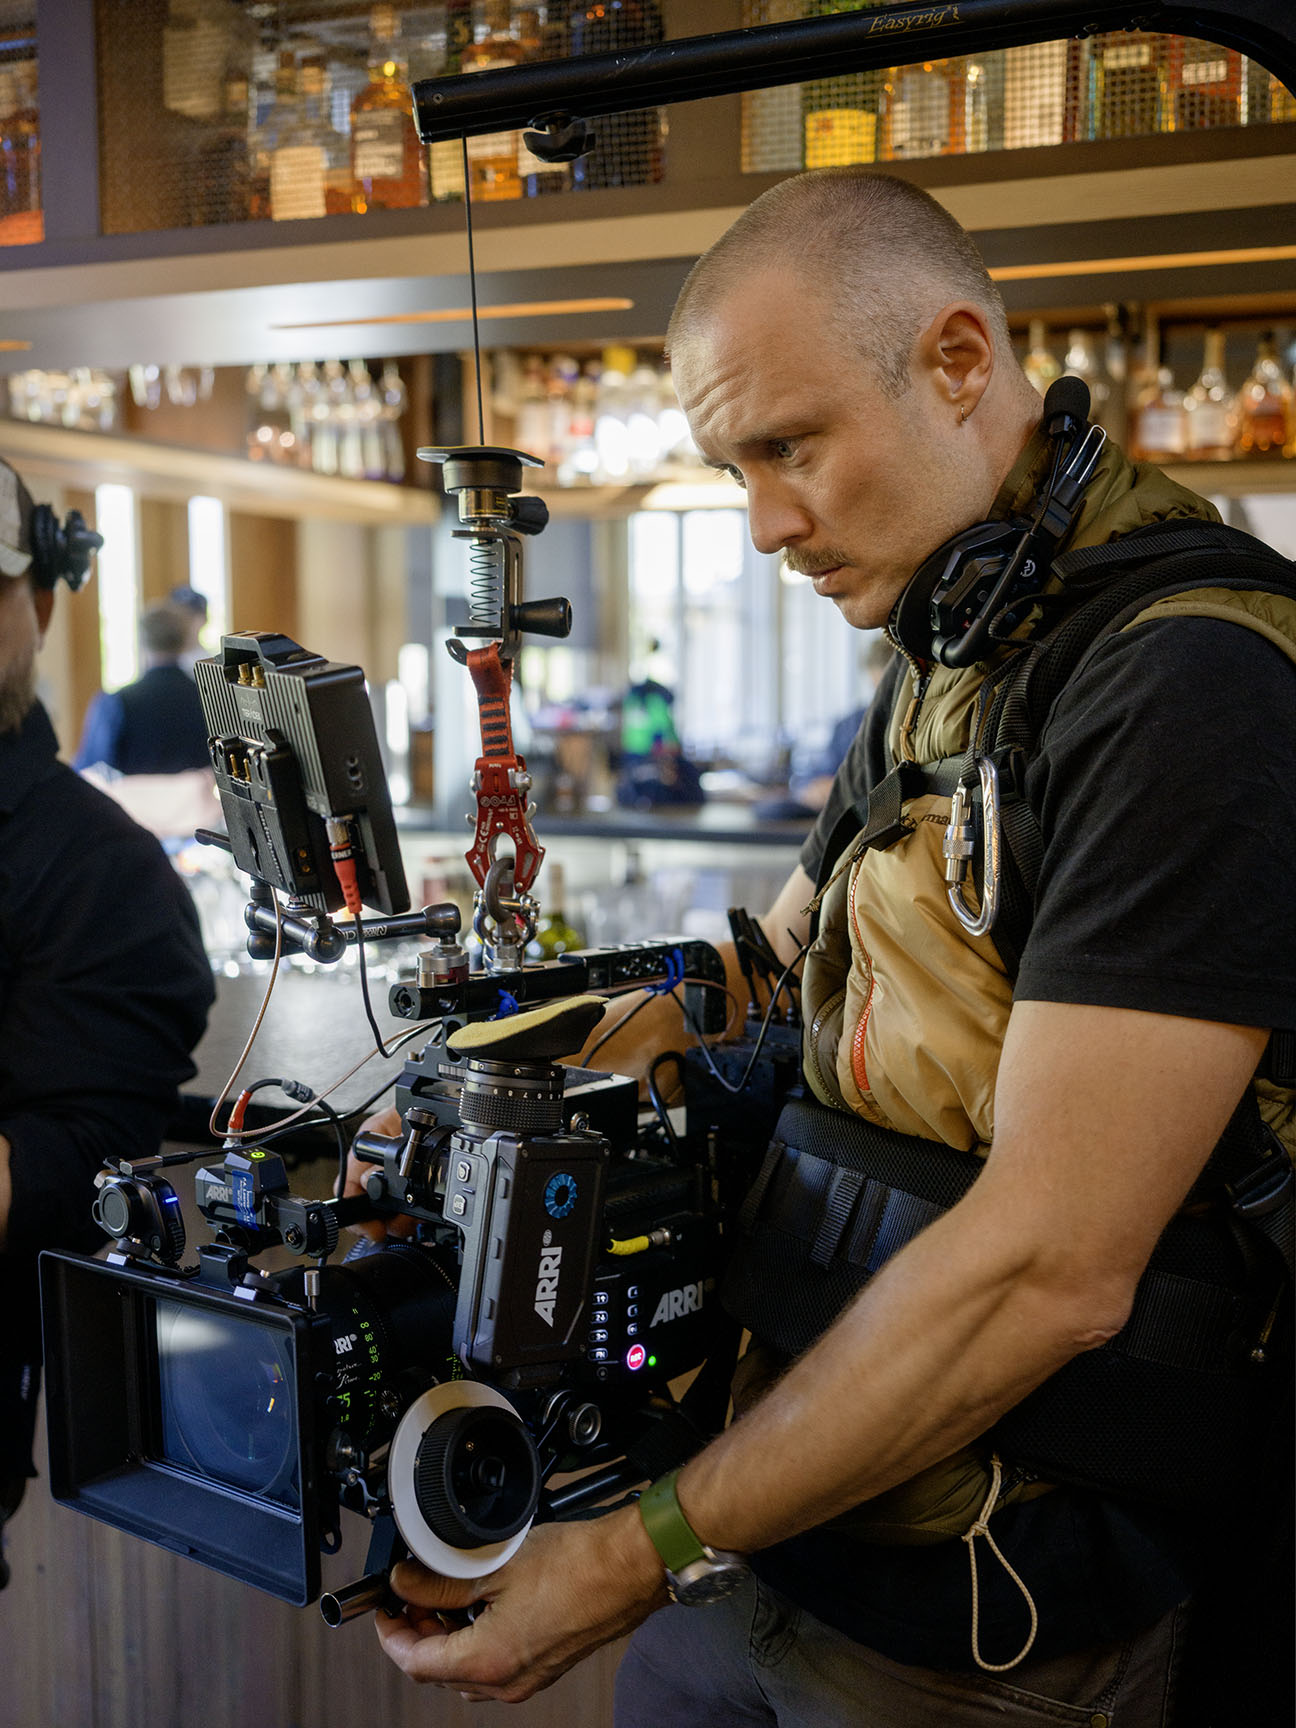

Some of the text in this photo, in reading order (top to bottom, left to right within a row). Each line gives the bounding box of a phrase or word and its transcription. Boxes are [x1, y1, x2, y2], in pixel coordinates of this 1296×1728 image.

[869, 9, 947, 33] Easyrig
[206, 1185, 229, 1202] ARRI
[534, 1246, 563, 1328] ARRI
[649, 1280, 703, 1328] ARRI
